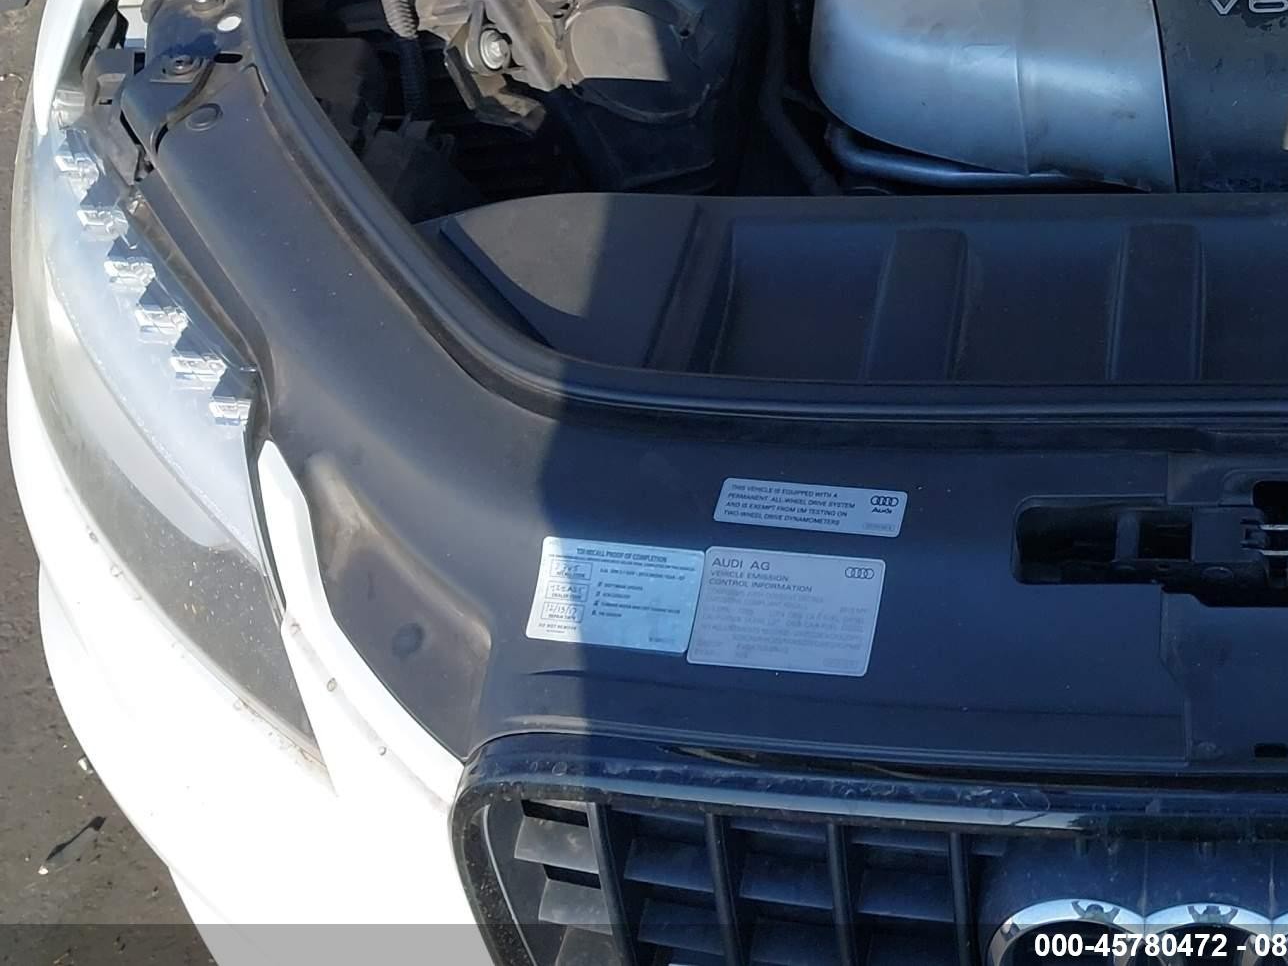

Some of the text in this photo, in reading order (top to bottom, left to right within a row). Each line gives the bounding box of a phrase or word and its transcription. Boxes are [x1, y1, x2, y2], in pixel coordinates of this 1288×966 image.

[782, 488, 813, 497] EQUIPPED
[749, 503, 775, 511] EXEMPT
[808, 508, 836, 516] TESTING
[828, 501, 855, 509] SYSTEM
[872, 506, 893, 514] Audi
[764, 513, 783, 521] DRIVE
[784, 514, 841, 526] DYNAMOMETERS
[712, 557, 770, 571] AUDI AG
[711, 570, 789, 582] VEHICLE EMISSION
[709, 578, 812, 593] CONTROL INFORMATION
